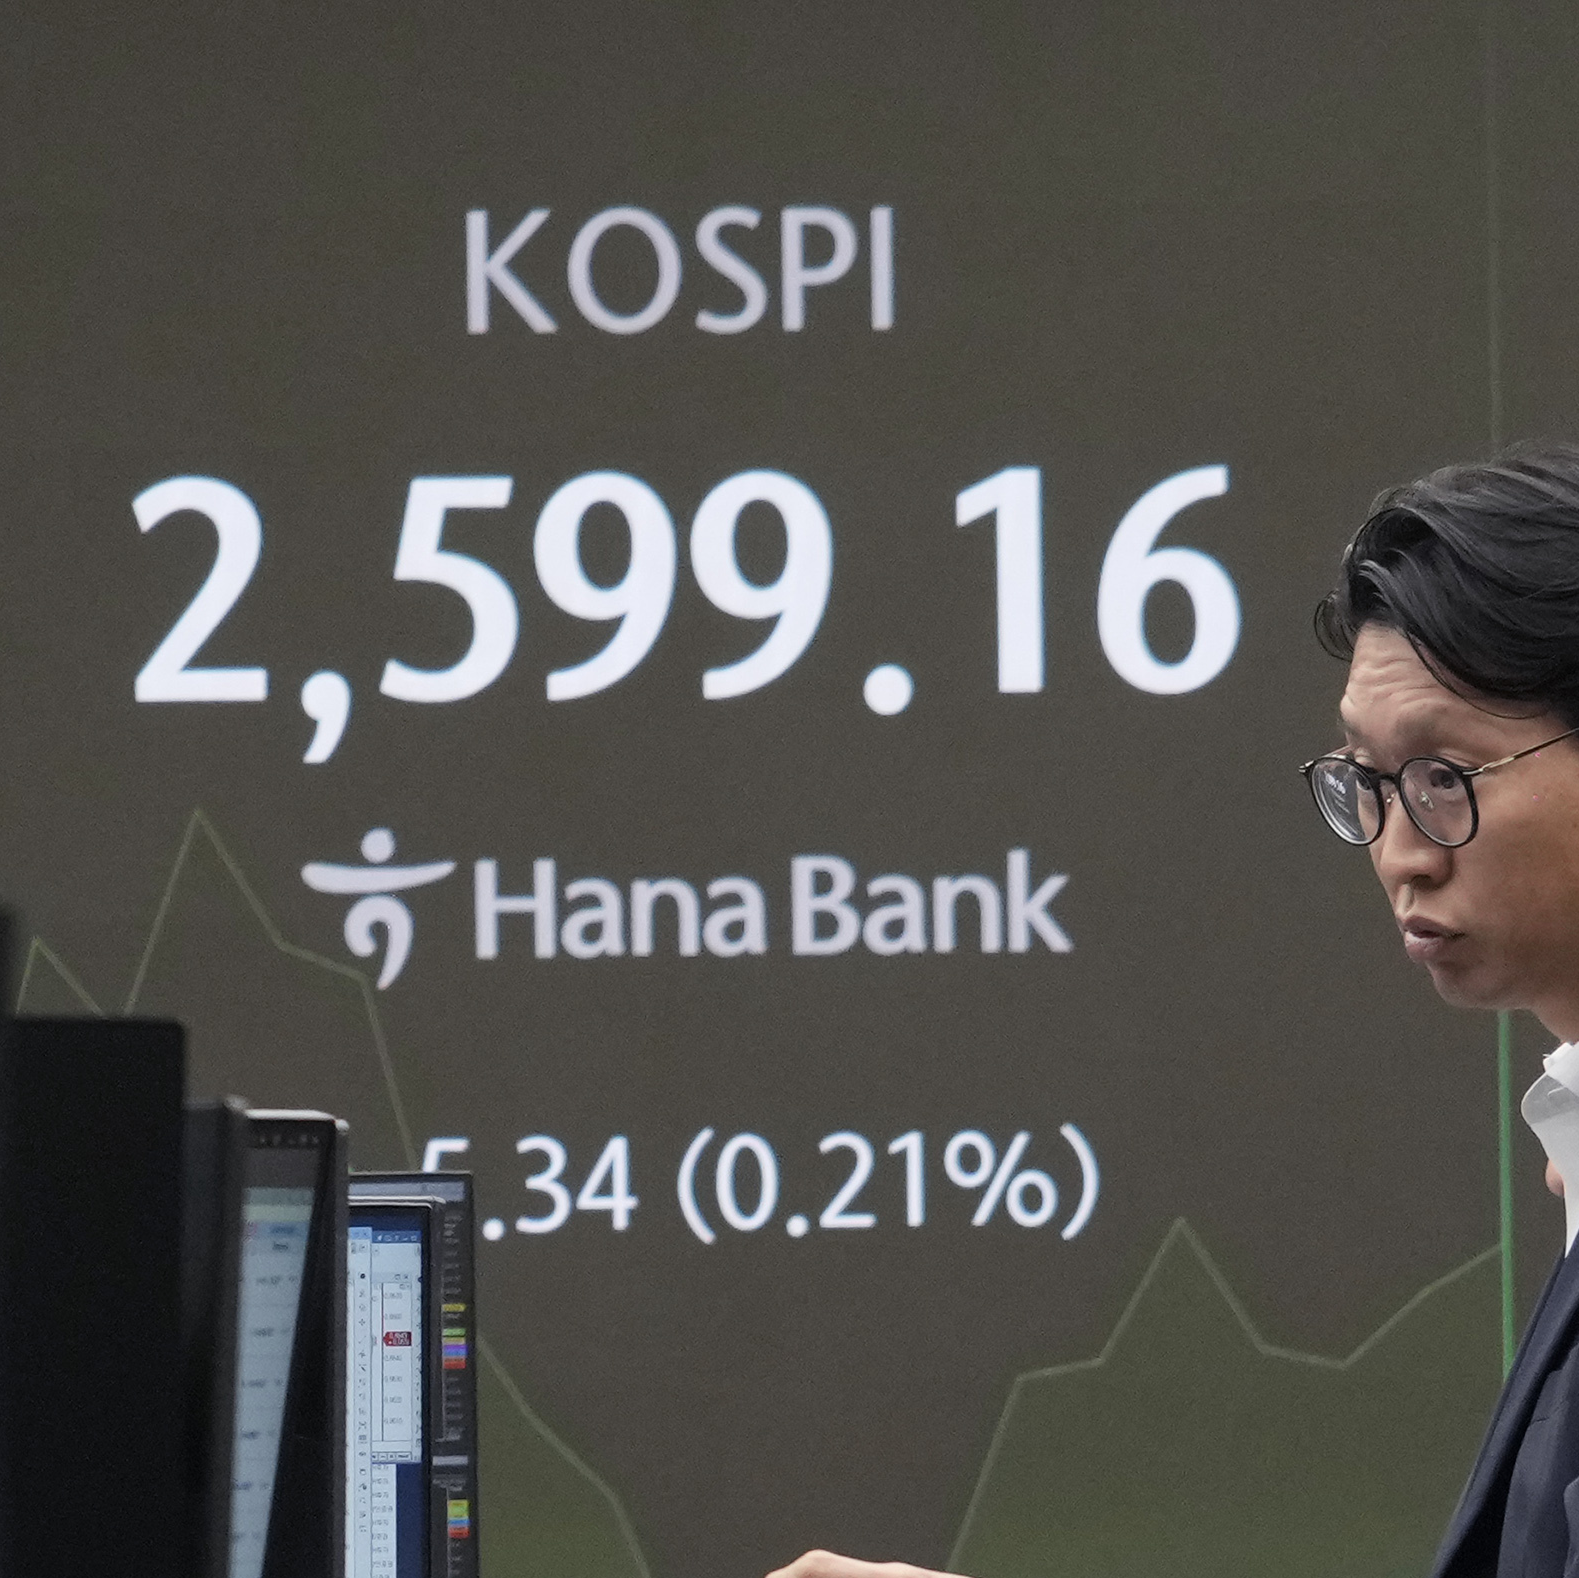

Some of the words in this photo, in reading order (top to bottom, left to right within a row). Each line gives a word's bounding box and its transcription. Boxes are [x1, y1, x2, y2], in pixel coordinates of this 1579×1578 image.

[465, 204, 894, 336] KOSPI
[131, 463, 1241, 765] 2,599.16
[473, 858, 768, 961] Hana
[790, 847, 1073, 957] Bank
[676, 1122, 1101, 1245] (0.21%)
